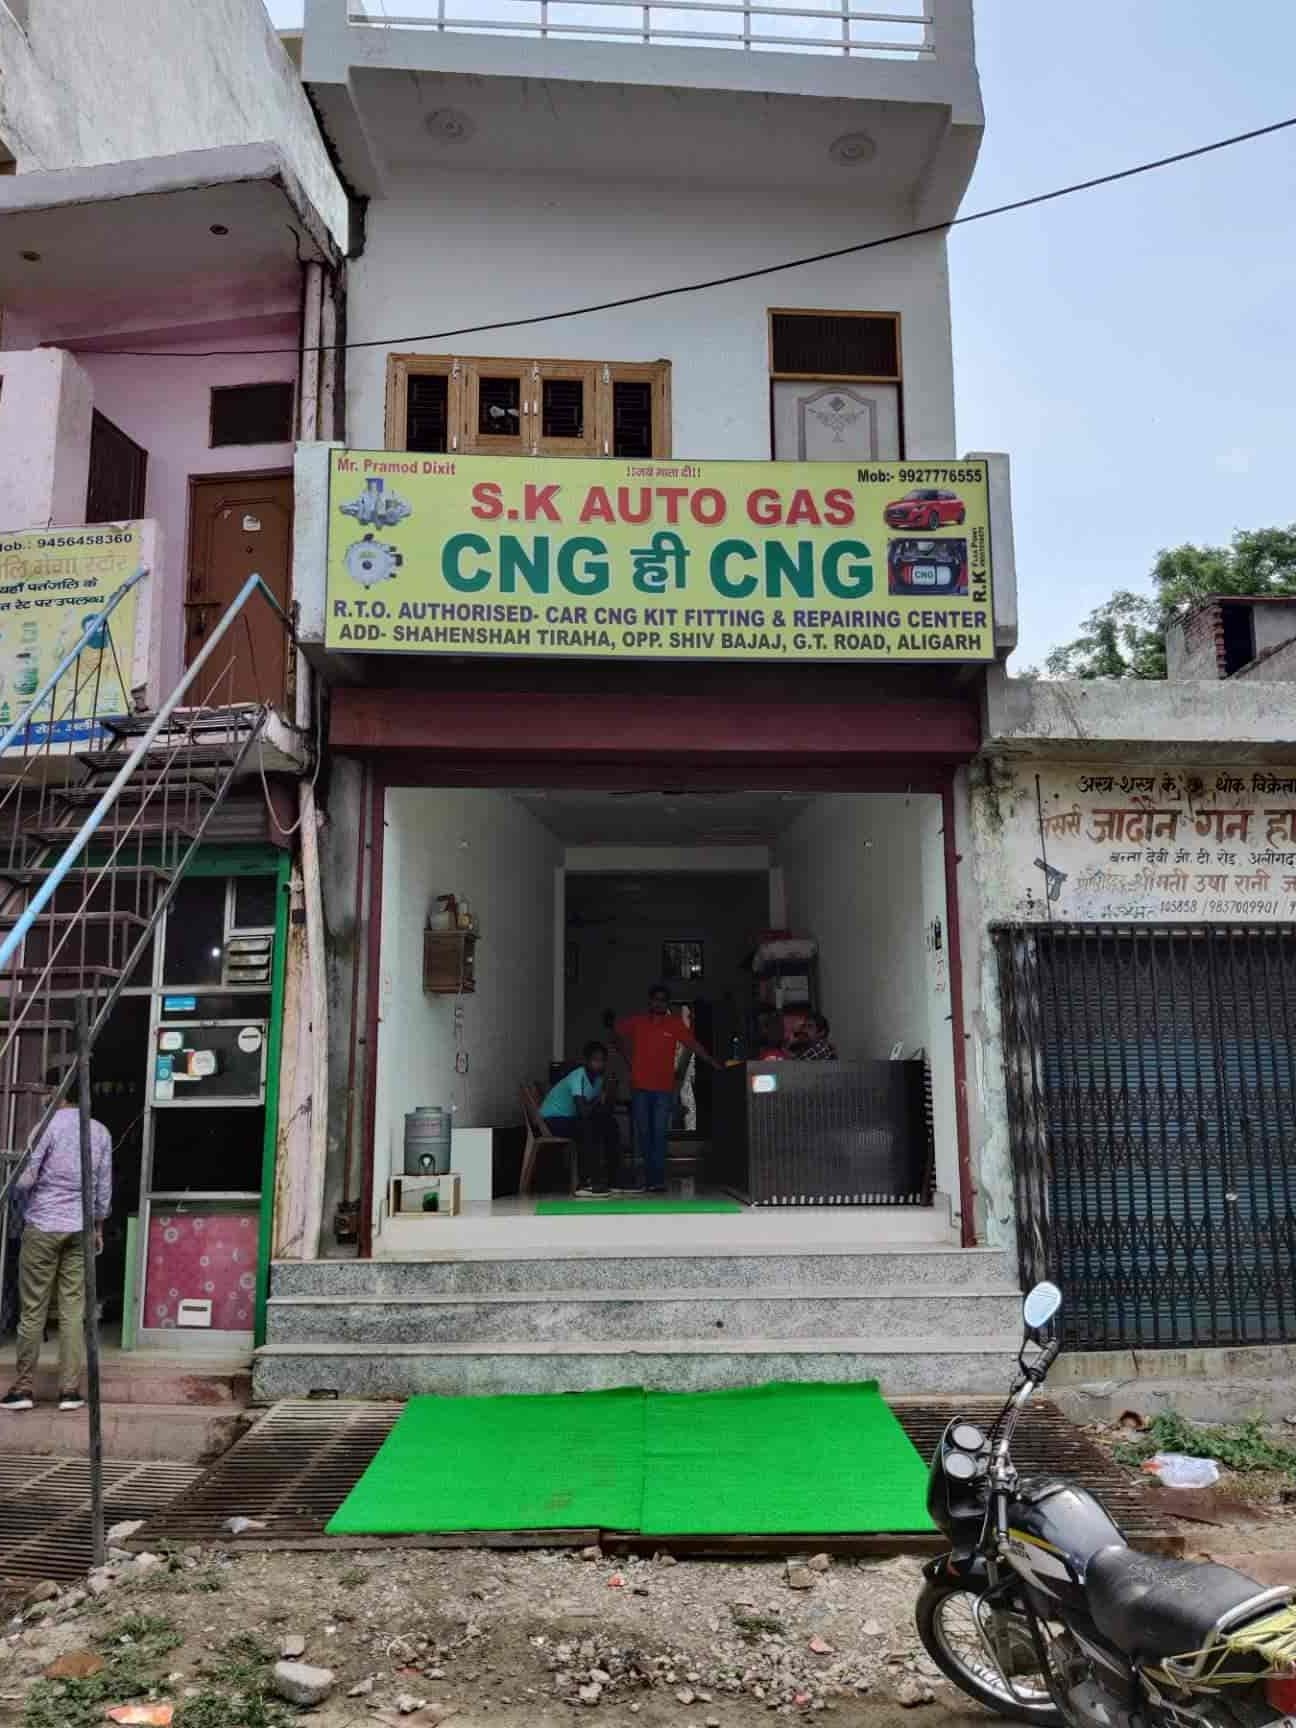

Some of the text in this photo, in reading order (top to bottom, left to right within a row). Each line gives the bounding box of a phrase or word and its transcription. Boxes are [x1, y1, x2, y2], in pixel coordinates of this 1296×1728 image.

[337, 458, 455, 475] Mr. Pramod Dixit
[898, 470, 982, 483] 9927776555
[471, 482, 855, 525] S.K AUTO GAS
[37, 533, 133, 548] 9456458360
[441, 531, 874, 599] CNG ही CNG
[914, 570, 934, 578] CNG
[333, 600, 987, 629] R.T.O. AUTHORISED- CAR CNG KIT FITTING & REPAIRING CENTER
[339, 624, 981, 653] ADD- SHAHENSHAH TIRAHA, OPP. SHIV BAJAJ, G.T. ROAD, ALIGARH
[1195, 809, 1254, 843] गन
[1264, 809, 1296, 850] हा
